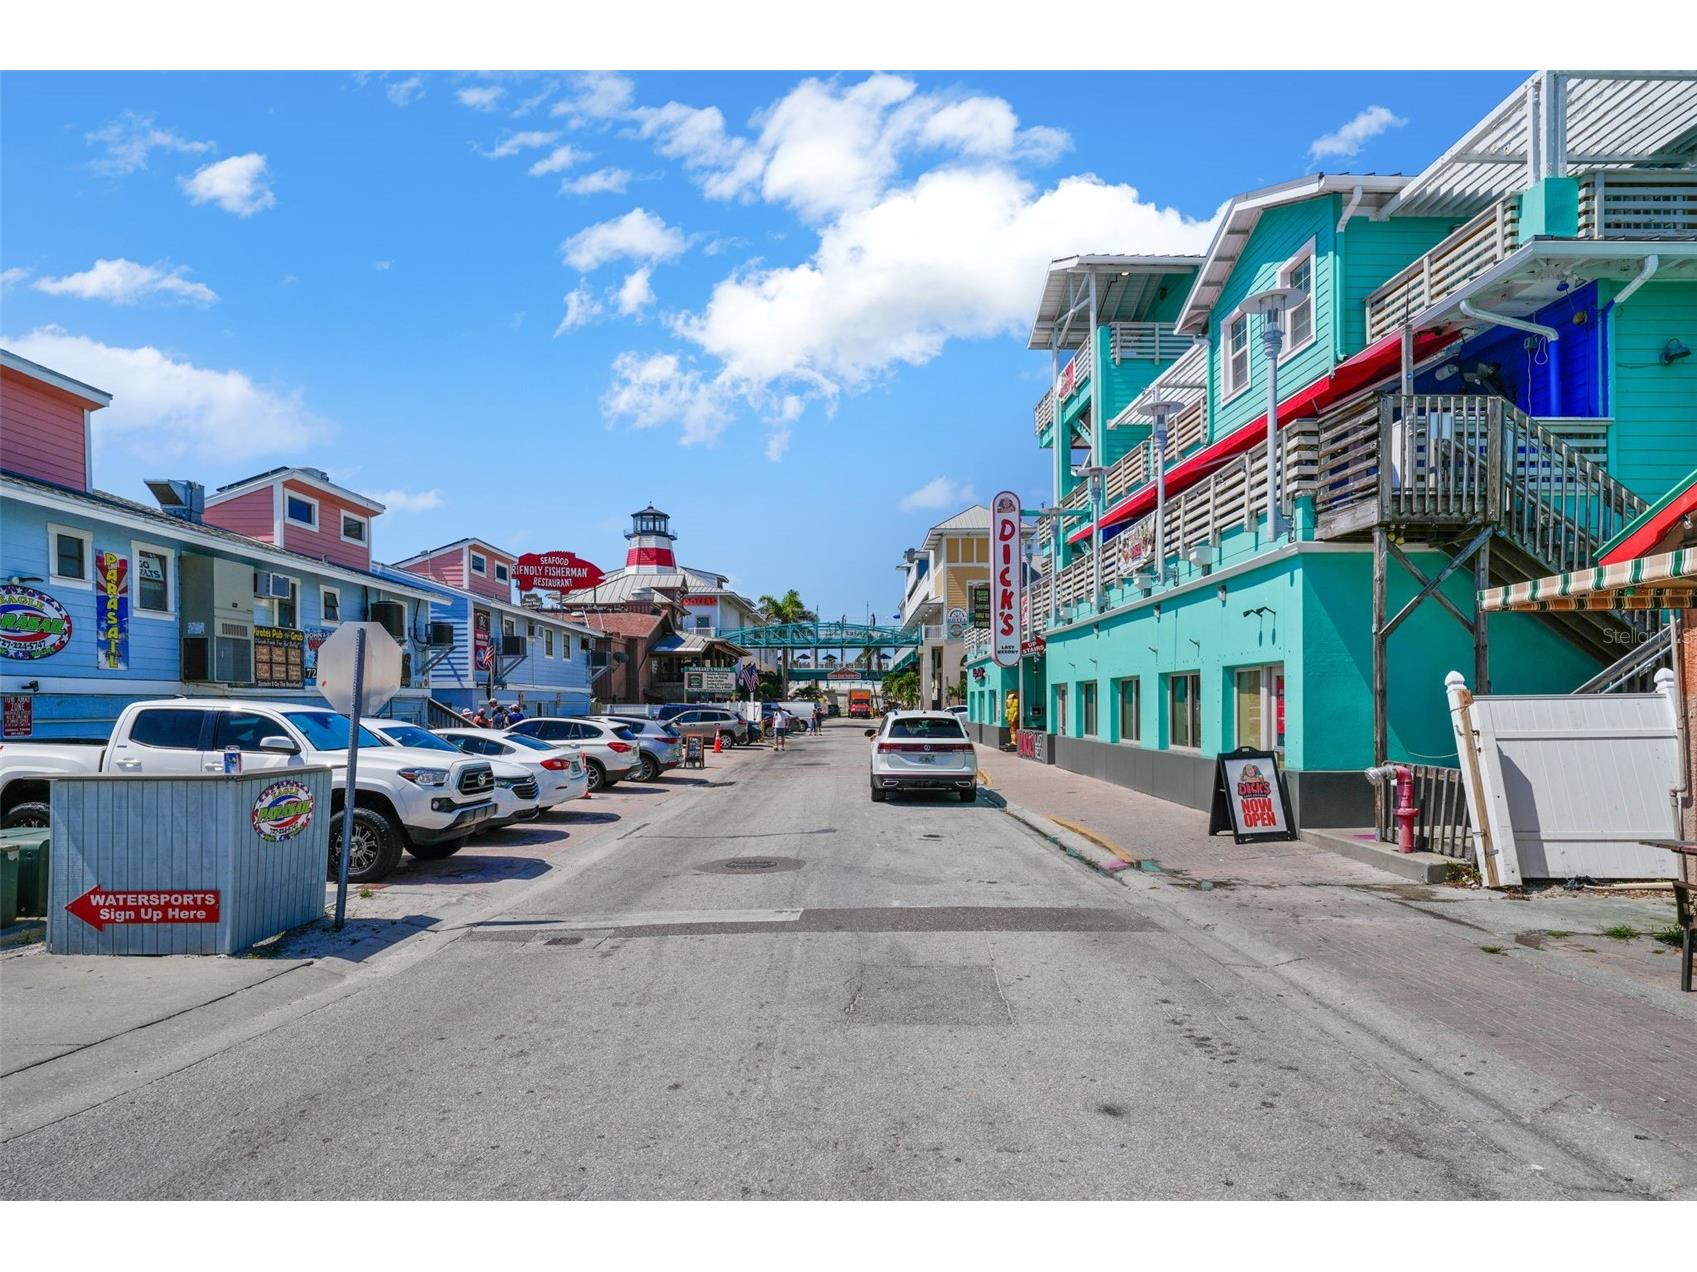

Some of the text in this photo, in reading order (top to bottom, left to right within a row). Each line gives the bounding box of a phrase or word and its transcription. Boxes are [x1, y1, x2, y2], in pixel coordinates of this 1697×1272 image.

[540, 556, 569, 566] SEAFOOD
[511, 565, 588, 578] RIENDLY FISHERMAN
[998, 518, 1016, 637] DICK'S
[533, 577, 573, 588] RESTAURANT
[104, 552, 119, 669] PARASAIL
[258, 800, 312, 823] PARASAIL
[1241, 799, 1272, 813] NOW
[1244, 813, 1276, 827] OPEN
[90, 893, 216, 906] WATERSPORTS
[100, 908, 206, 922] Sign Up Here
